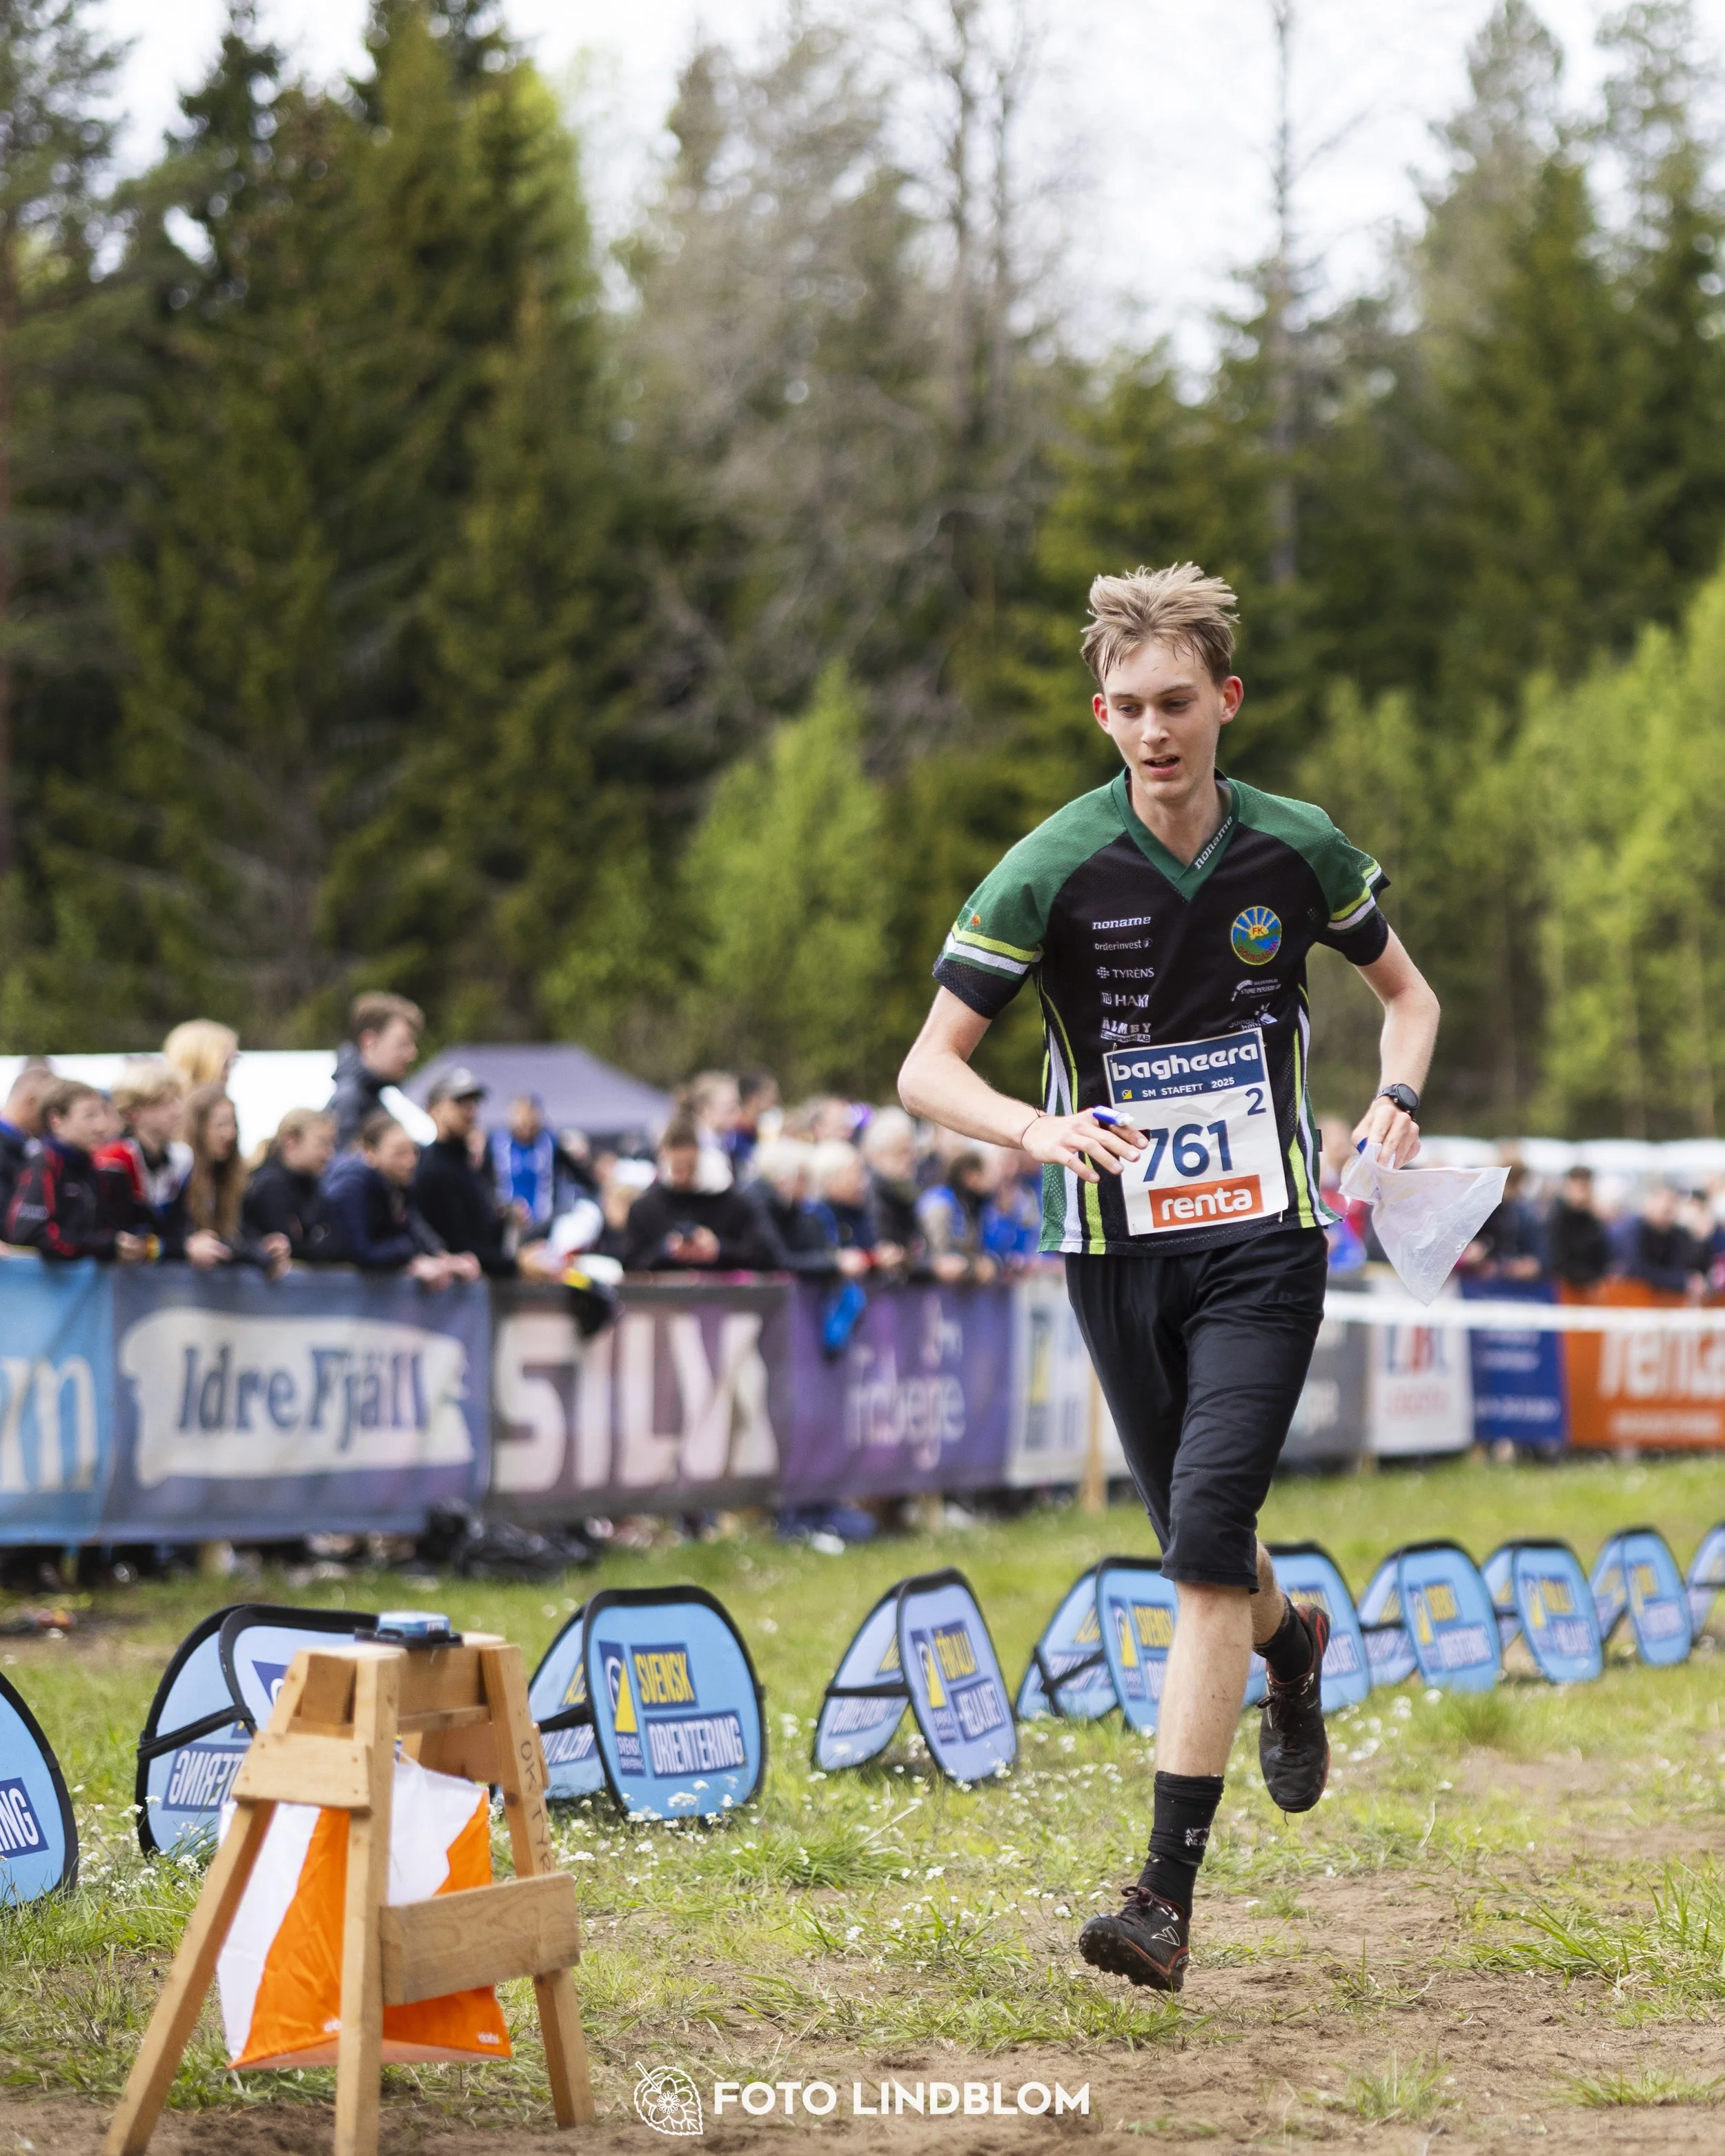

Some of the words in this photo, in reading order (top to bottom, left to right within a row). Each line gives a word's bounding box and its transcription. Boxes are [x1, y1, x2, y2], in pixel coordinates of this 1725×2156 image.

[1194, 816, 1232, 869] noname
[1092, 916, 1151, 929] noname
[1252, 927, 1264, 935] FK
[1111, 1043, 1259, 1081] bagheera
[1142, 1089, 1156, 1098] SM
[1161, 1083, 1203, 1096] STAFETT
[1212, 1077, 1235, 1089] 2025
[1245, 1087, 1267, 1116] 2
[1143, 1120, 1233, 1183] 761
[1162, 1187, 1253, 1220] renta
[634, 1652, 695, 1704] SVENSK
[648, 1716, 744, 1774] ORIENTERING
[520, 1740, 537, 1792] OK
